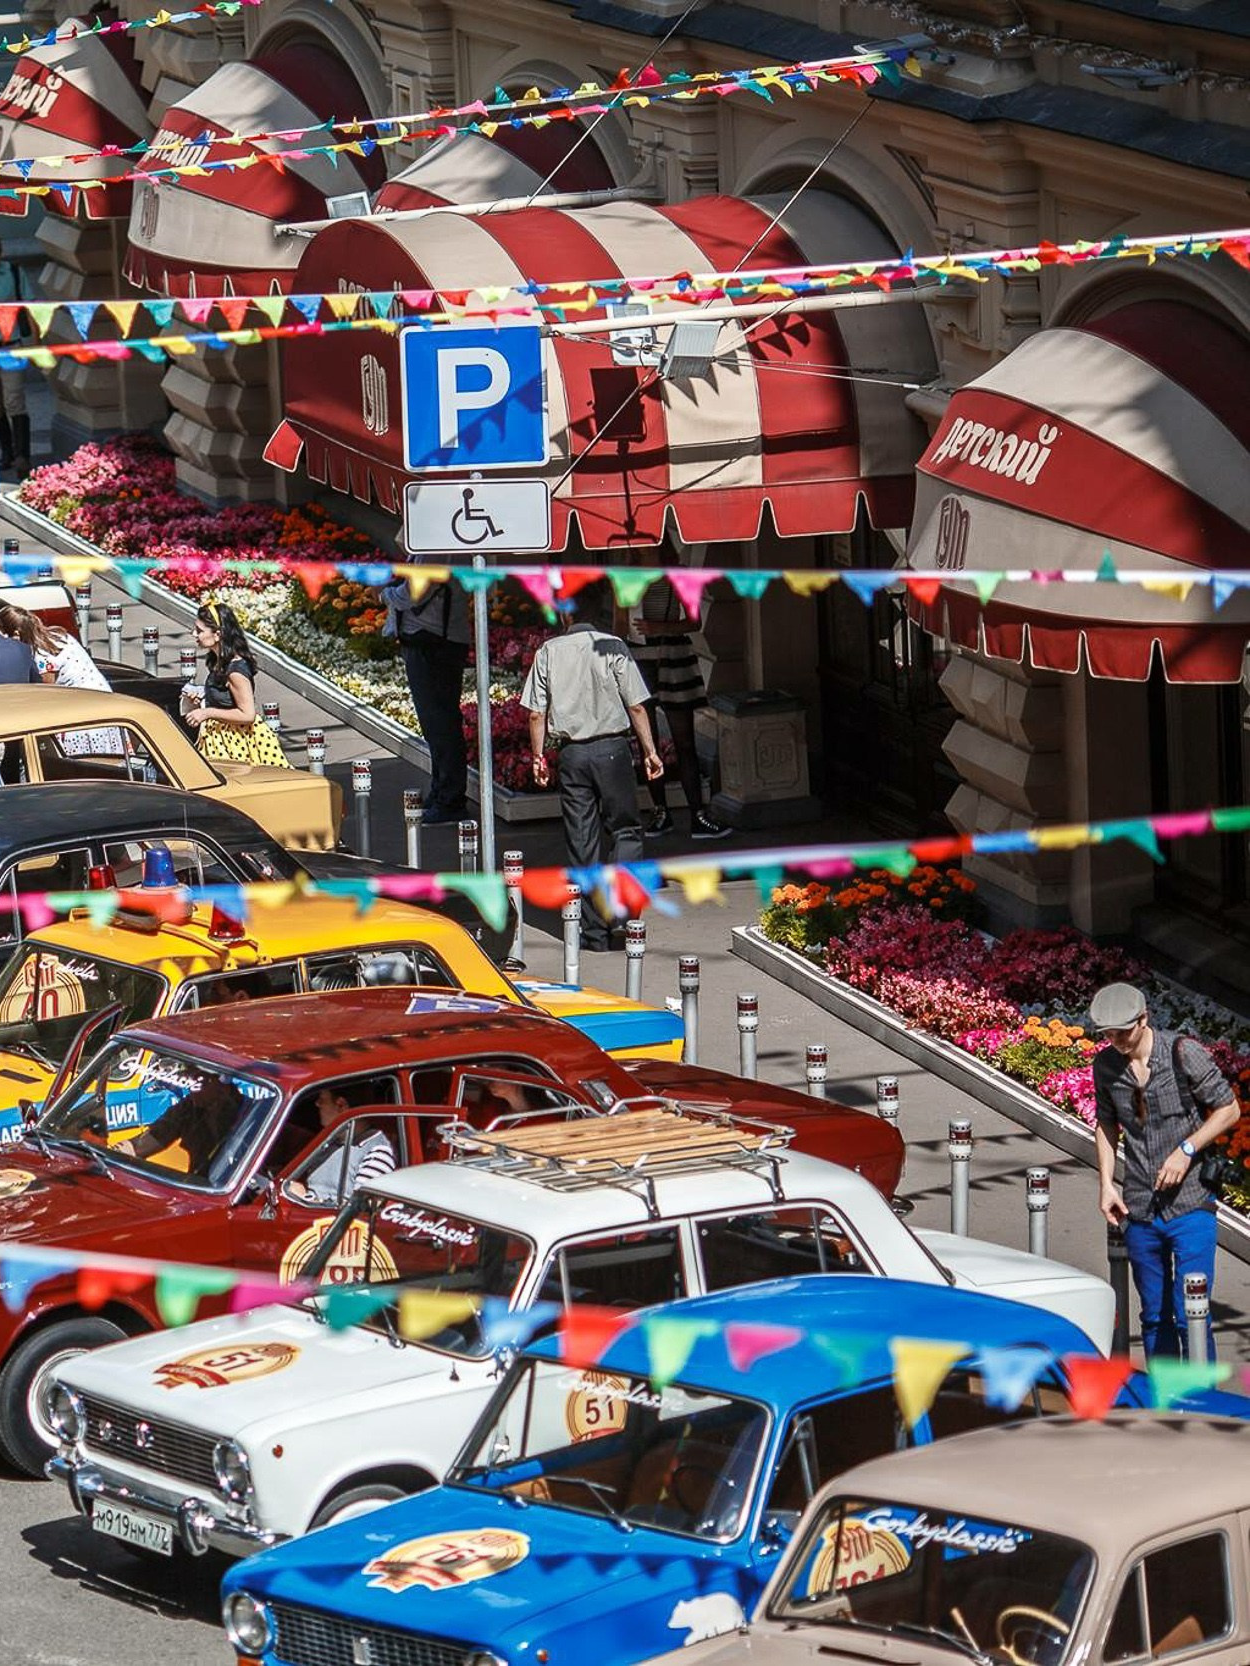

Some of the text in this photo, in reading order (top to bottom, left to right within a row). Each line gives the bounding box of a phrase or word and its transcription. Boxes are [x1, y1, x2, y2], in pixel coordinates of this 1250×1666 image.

[437, 347, 511, 449] P
[105, 1102, 139, 1127] ЦИЯ
[379, 1202, 475, 1246] Gorkyclassic
[203, 1351, 264, 1371] 51
[585, 1396, 614, 1426] 51
[94, 1509, 146, 1544] М919НМ
[865, 1508, 1018, 1554] Gorkyclassic
